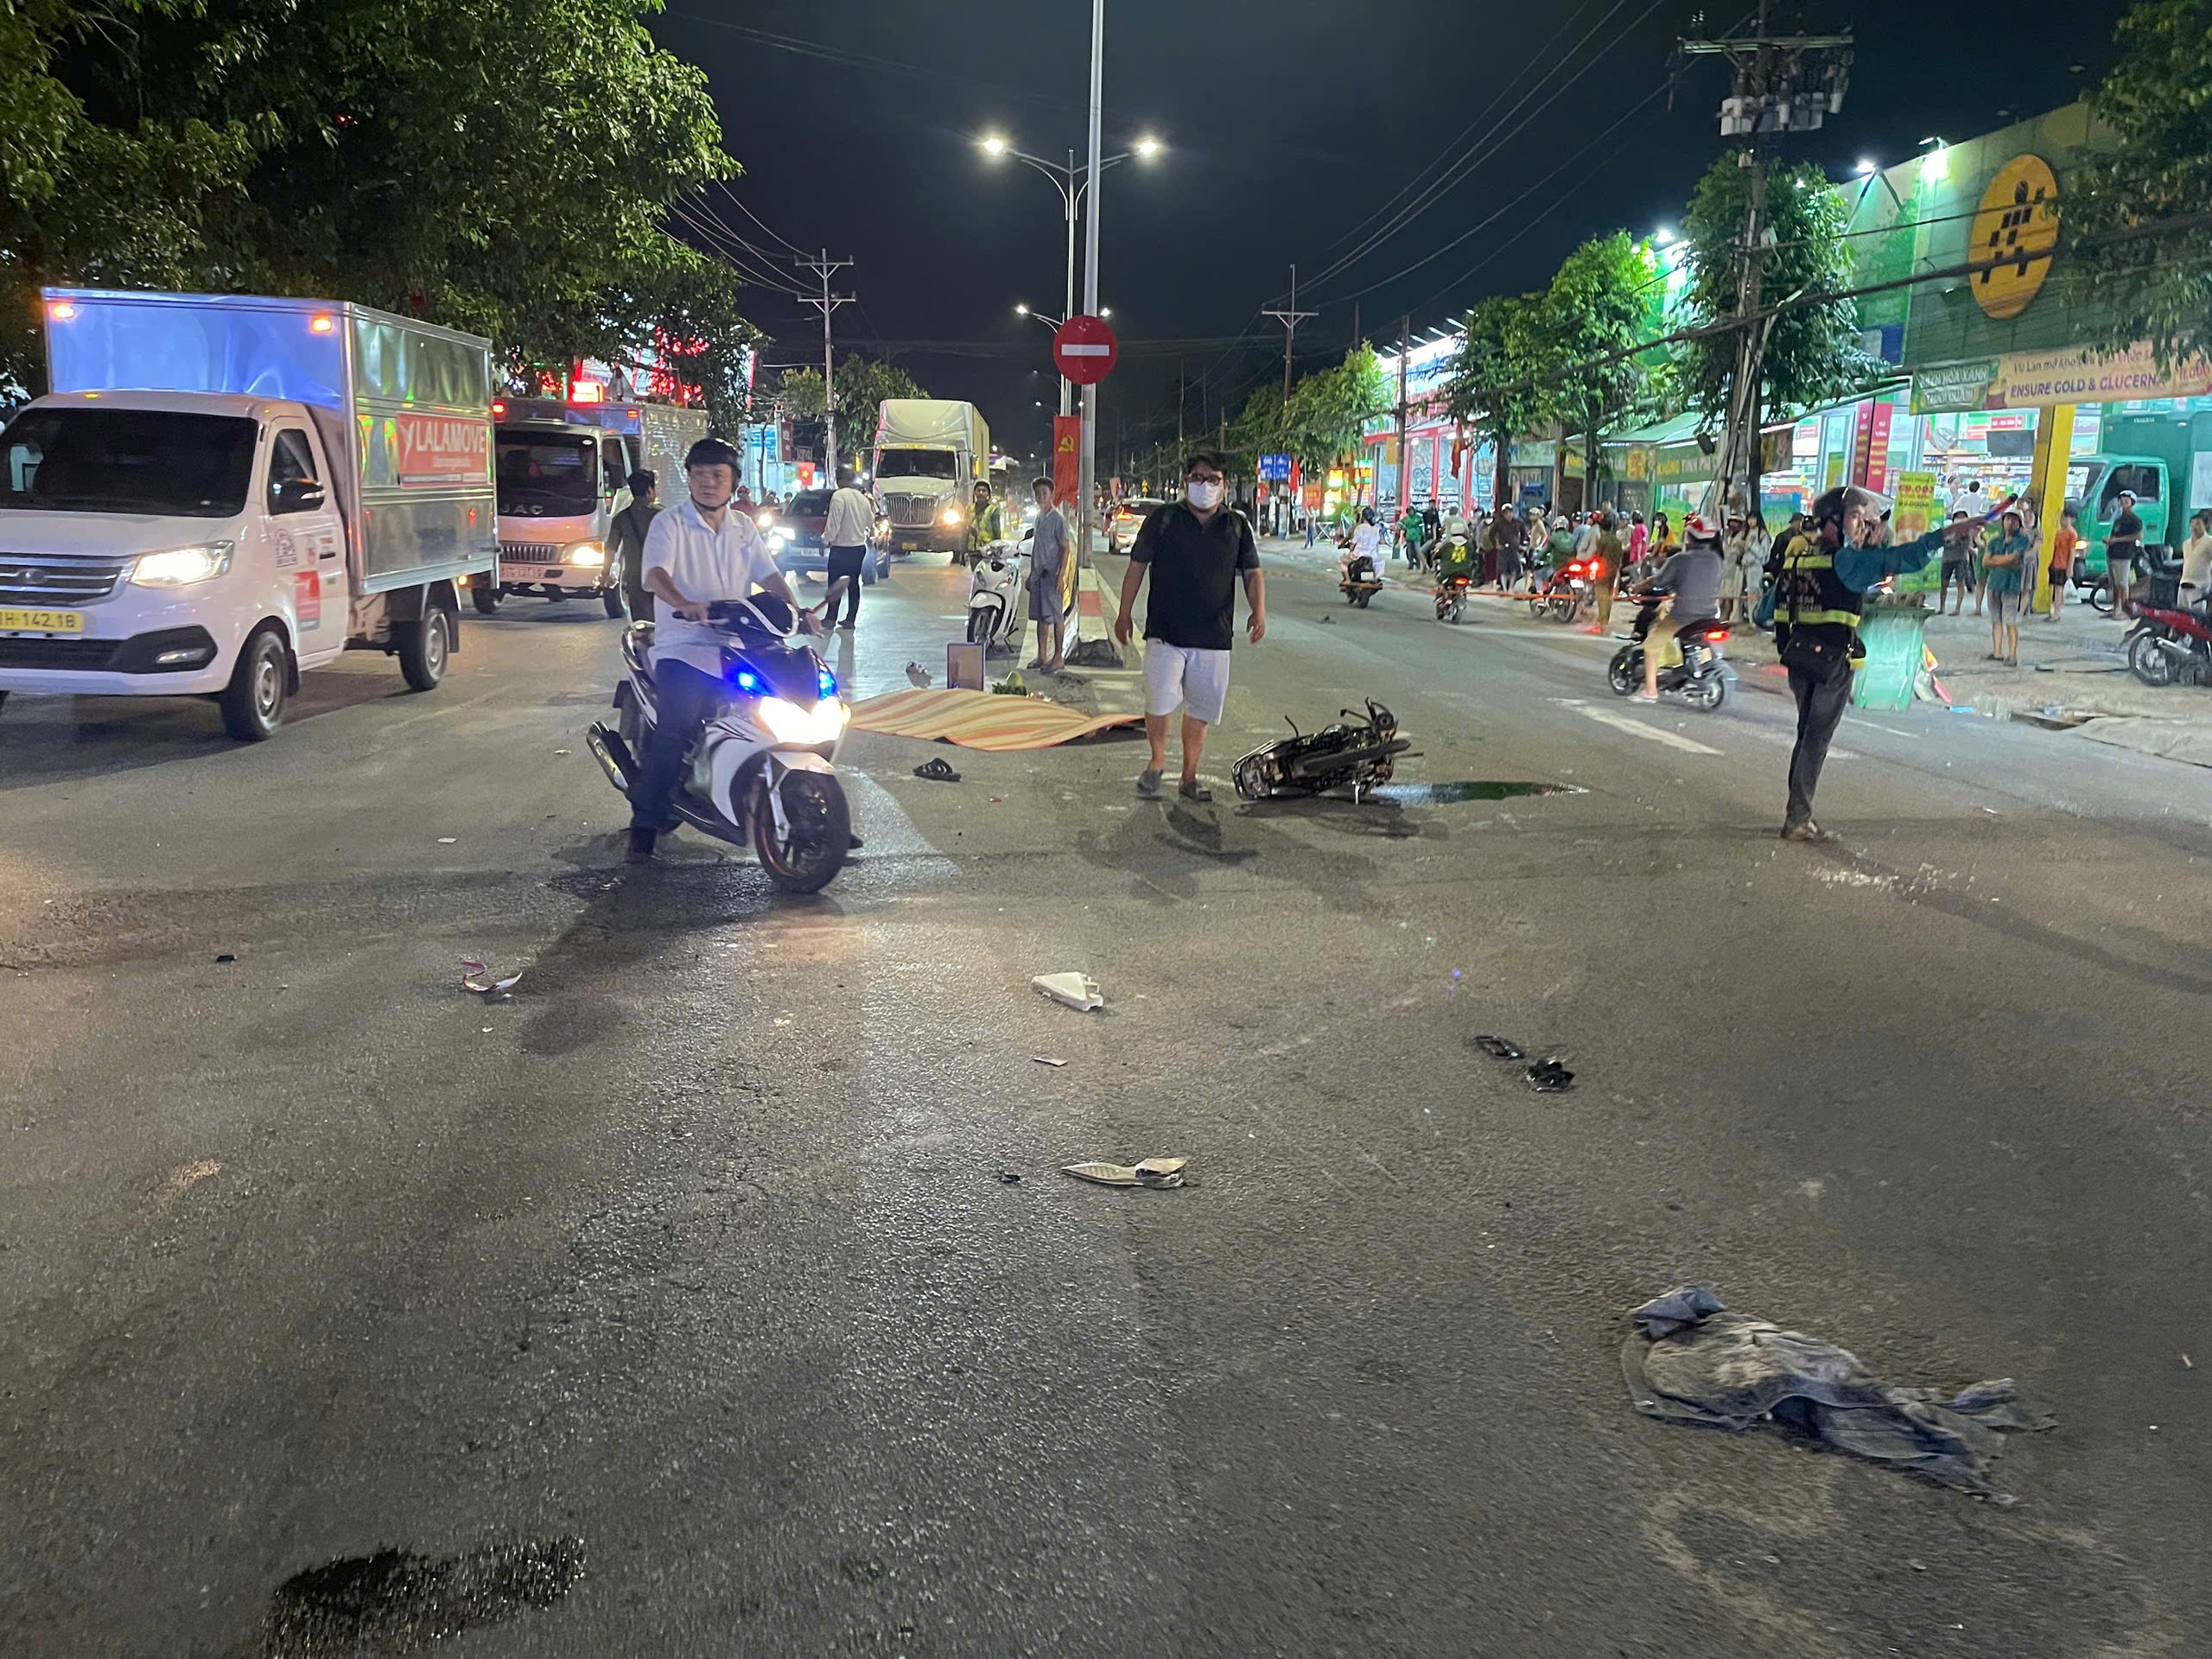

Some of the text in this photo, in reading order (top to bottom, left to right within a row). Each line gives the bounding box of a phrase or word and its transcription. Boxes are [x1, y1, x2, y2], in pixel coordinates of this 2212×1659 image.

[2011, 373, 2160, 398] ENSURE GOLD & GLUCERN
[416, 420, 486, 454] LALAMOVE
[501, 503, 544, 515] JAC
